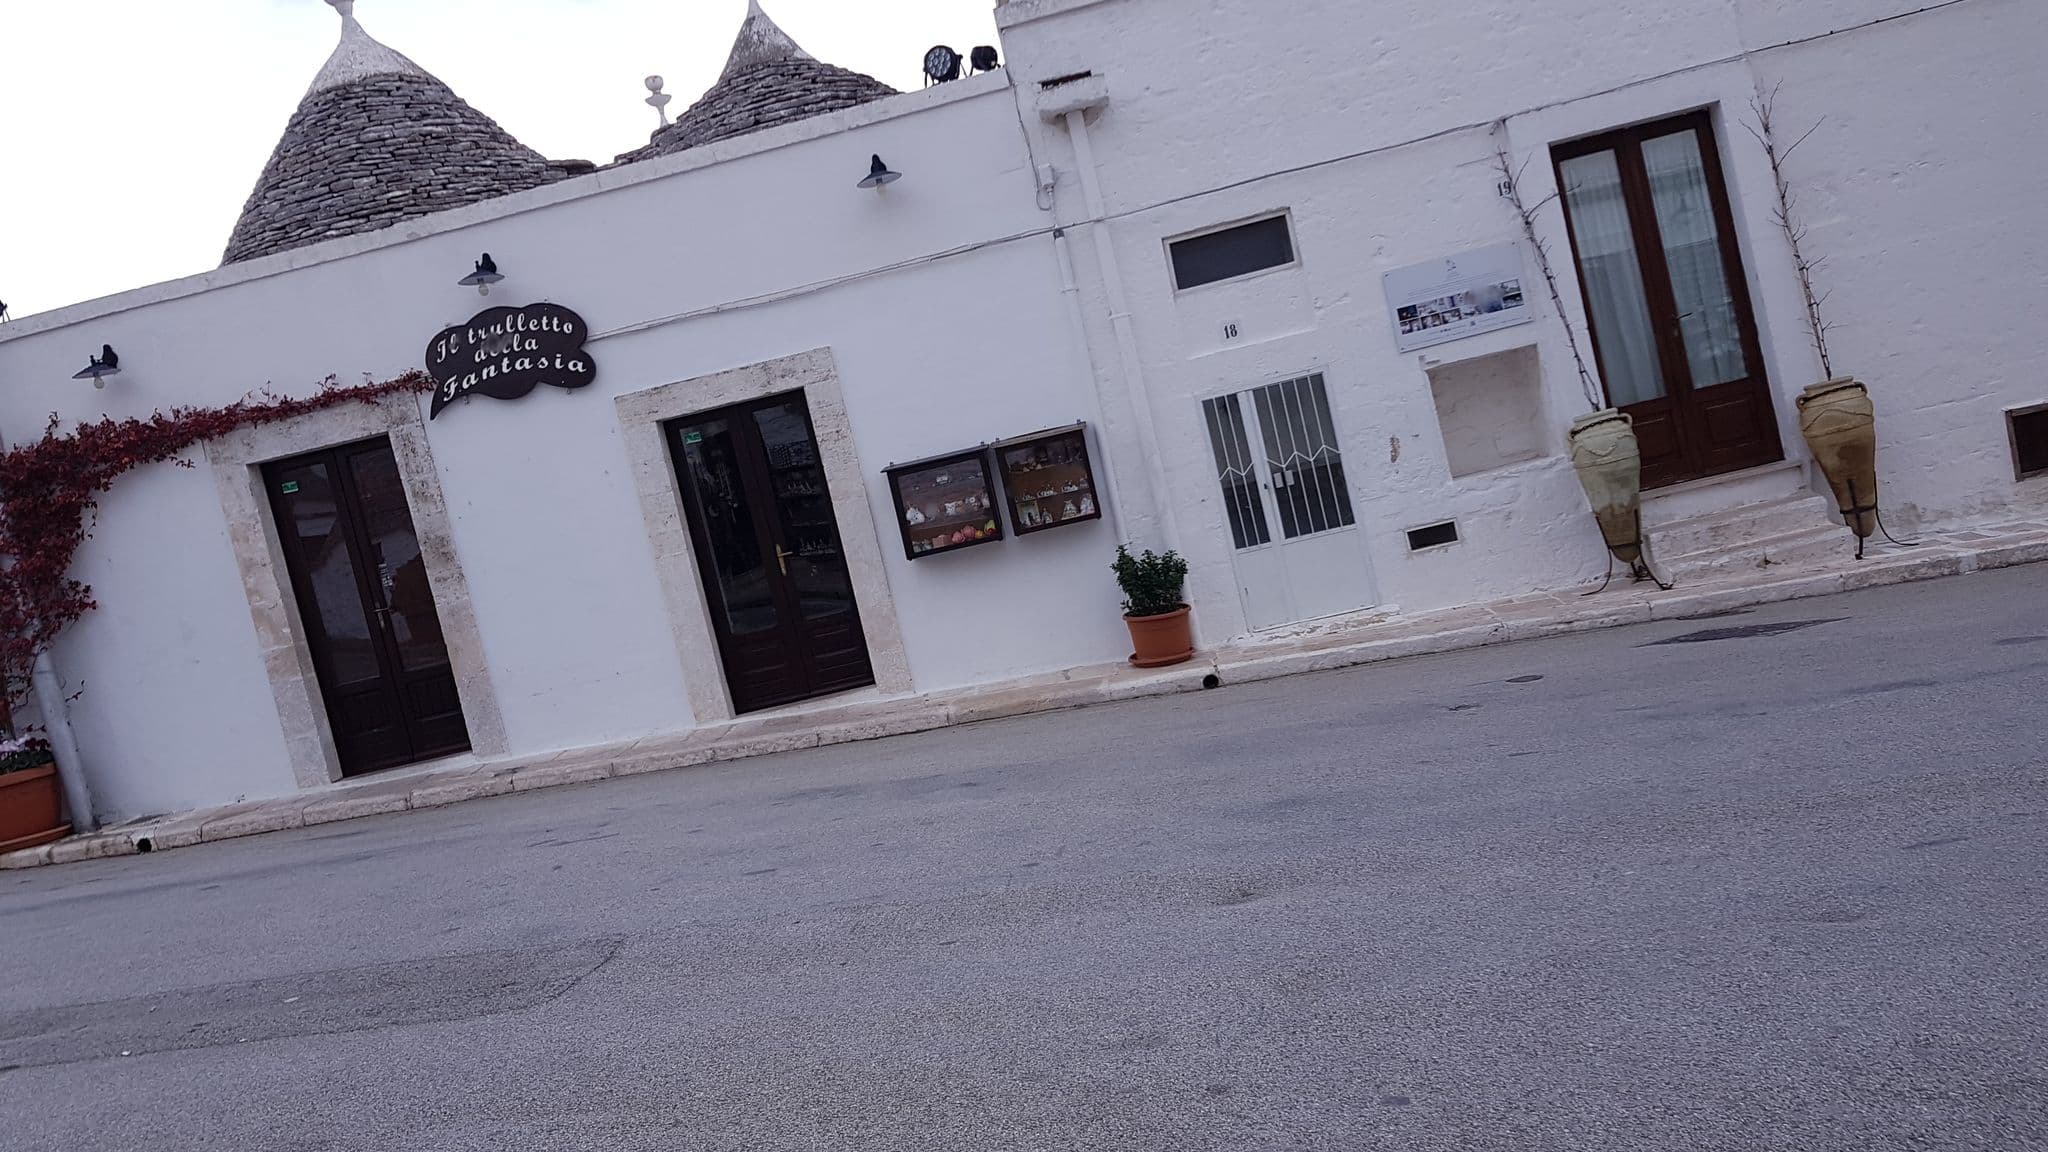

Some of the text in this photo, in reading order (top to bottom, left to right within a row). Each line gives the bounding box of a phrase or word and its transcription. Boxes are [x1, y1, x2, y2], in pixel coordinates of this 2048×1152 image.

[1497, 180, 1512, 197] 19
[467, 312, 573, 345] trulletto
[1223, 323, 1238, 339] 18
[443, 353, 587, 402] Fantasia
